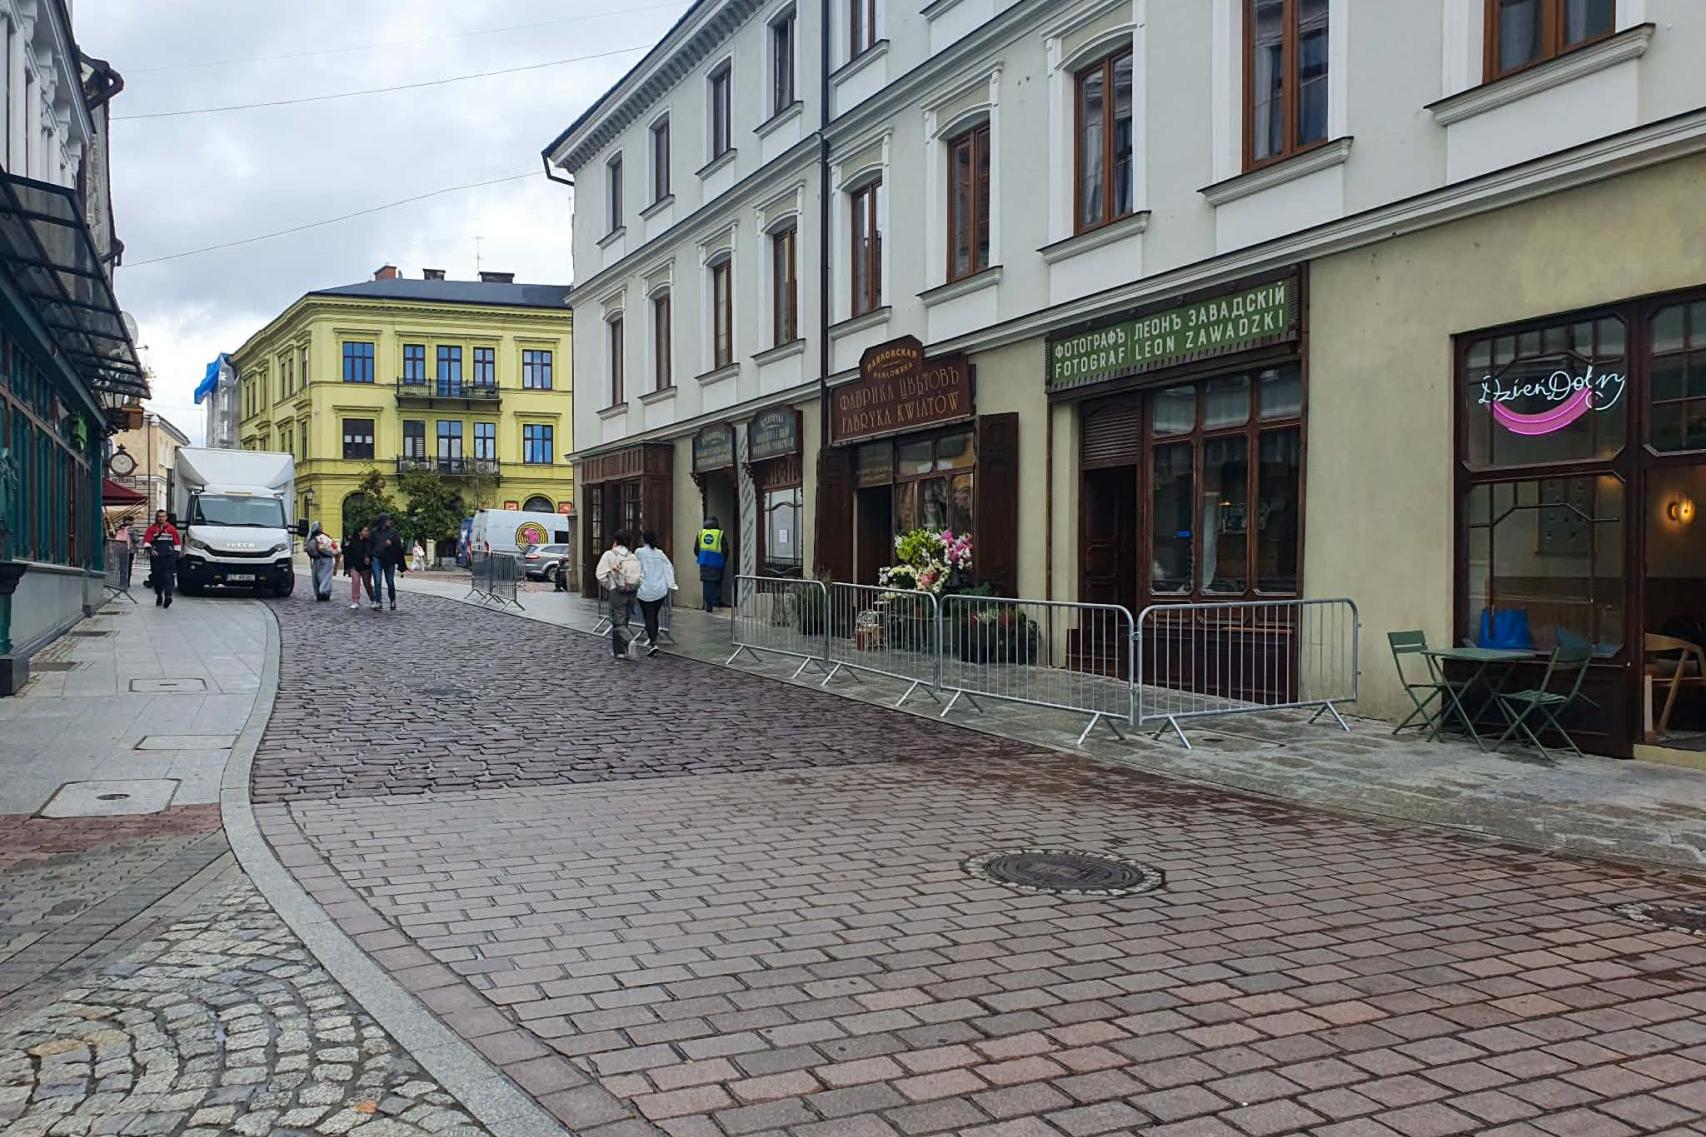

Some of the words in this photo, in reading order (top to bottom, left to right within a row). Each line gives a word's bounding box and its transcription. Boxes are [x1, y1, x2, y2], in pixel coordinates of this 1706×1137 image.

[1055, 328, 1125, 359] ФОТОГРАФЪ
[1134, 314, 1181, 341] ЛЕОНЪ
[1055, 347, 1125, 378] FOTOGRAF
[1135, 335, 1175, 360] LEON
[1186, 309, 1283, 349] ZAWADZKI
